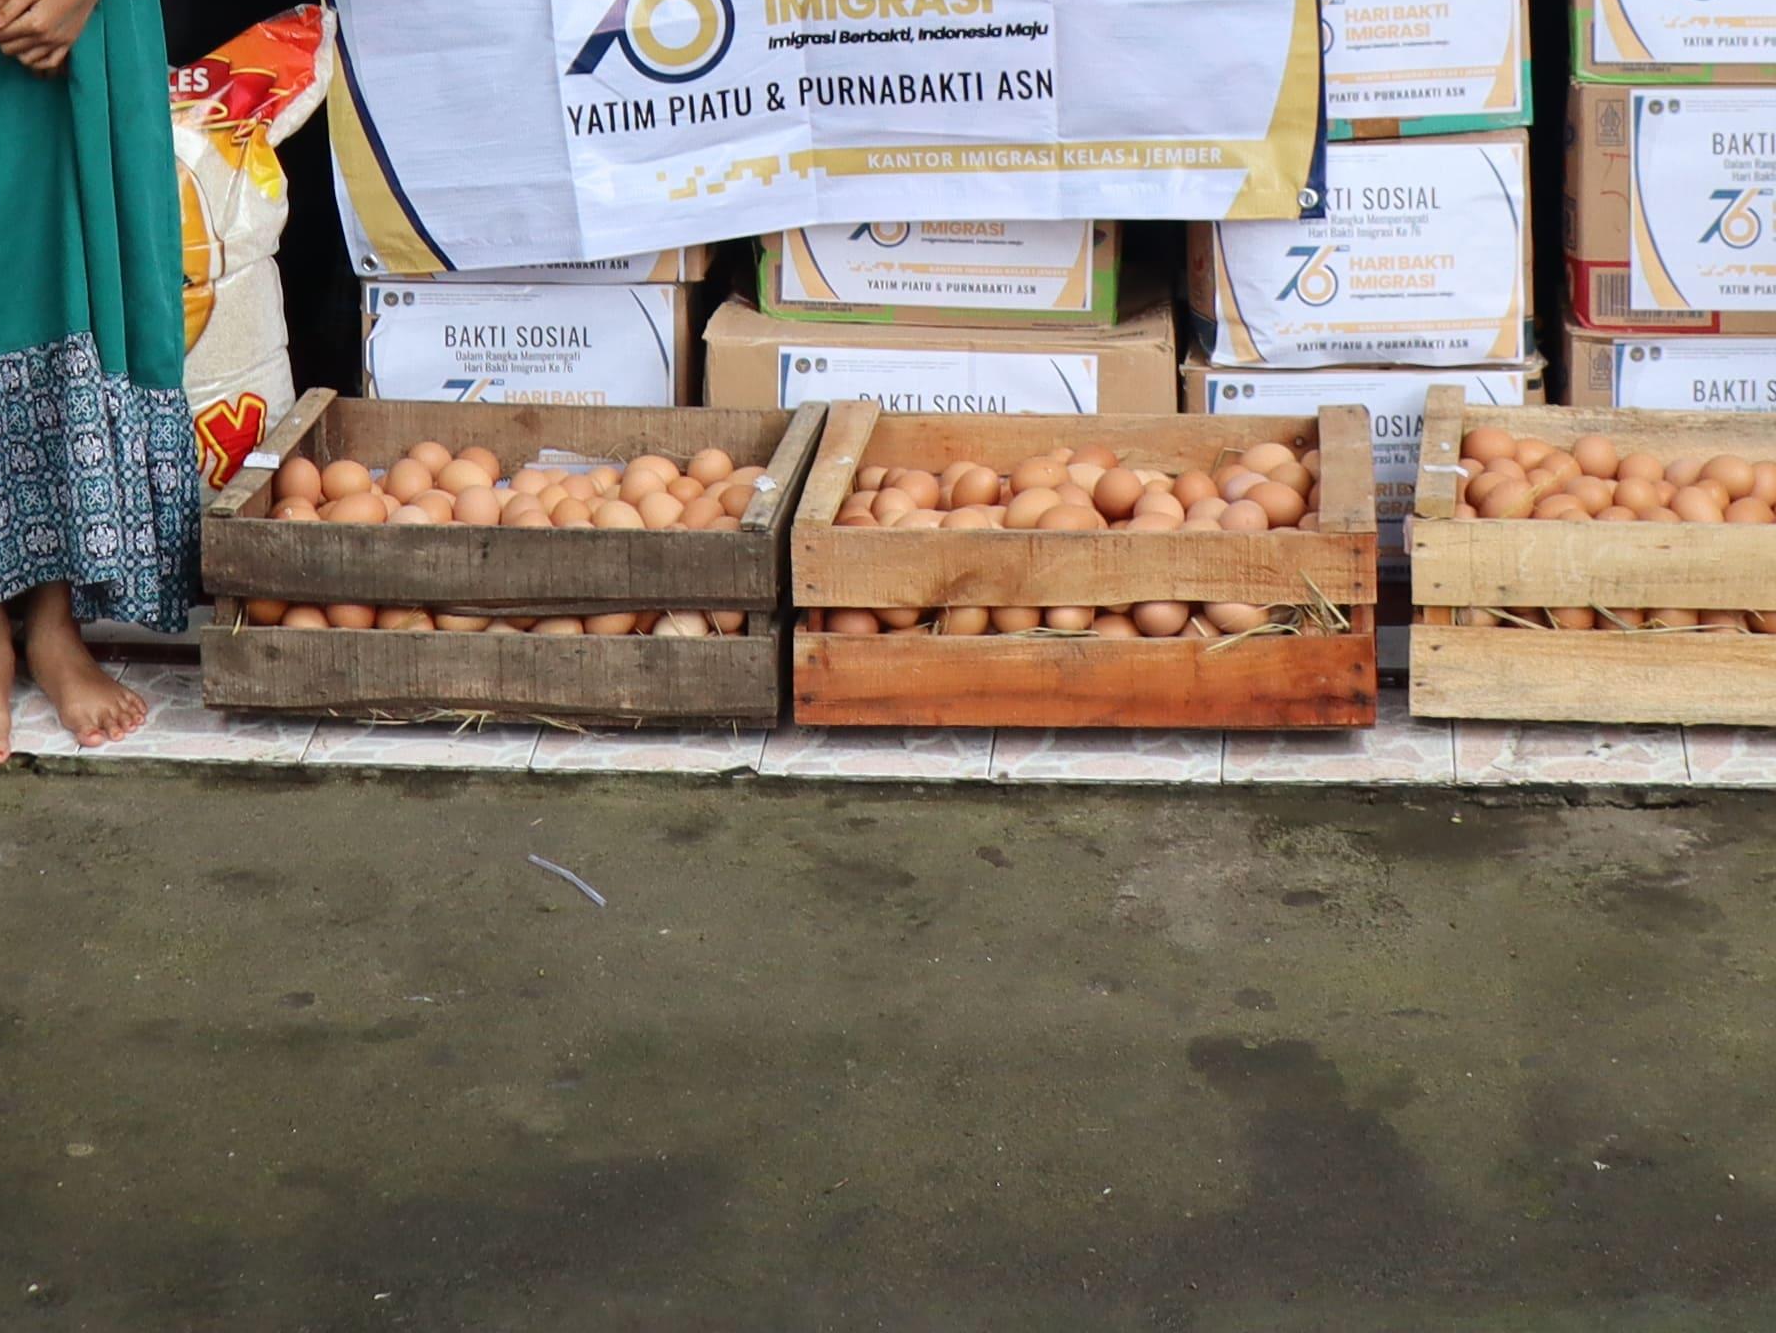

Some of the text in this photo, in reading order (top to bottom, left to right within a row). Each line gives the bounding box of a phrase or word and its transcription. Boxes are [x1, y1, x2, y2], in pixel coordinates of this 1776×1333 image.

[1345, 3, 1449, 23] HARI BAKTI
[768, 23, 1049, 50] Imigrasi Berbakti, Indonesia Maju
[1346, 23, 1431, 41] IMIGRASI
[1683, 36, 1715, 48] YATIM
[1718, 36, 1749, 48] PIATU
[566, 69, 1054, 137] YATIM PIATU & PURNABAKTI ASN
[1329, 87, 1466, 103] PIATU PURNABAKTI ASN
[1712, 133, 1775, 155] BAKTI
[867, 147, 1223, 169] KANTOR IMIGRASI KELAS I JEMBER
[1362, 186, 1441, 210] SOSIAL
[922, 221, 1004, 237] IMIGRASI
[1349, 254, 1455, 271] HARI BAKTI
[867, 279, 897, 291] YATIM
[900, 280, 932, 291] PIATU
[946, 282, 1013, 294] PURNABAKTI
[1017, 284, 1036, 294] ASN
[1349, 274, 1436, 289] IMIGRASI
[1718, 284, 1750, 296] YATIM
[445, 325, 592, 349] BAKTI SOSIAL
[1296, 338, 1469, 352] YATIM PIATU PURNABAKTI ASN
[455, 351, 581, 364] Dalam Rangka Memperingati
[463, 362, 483, 373] Hari
[485, 362, 508, 373] Bakti
[510, 362, 546, 374] Imigrasi
[504, 390, 606, 406] HARI BAKTI
[1693, 379, 1756, 402] BAKTI
[1375, 414, 1424, 437] OSIA
